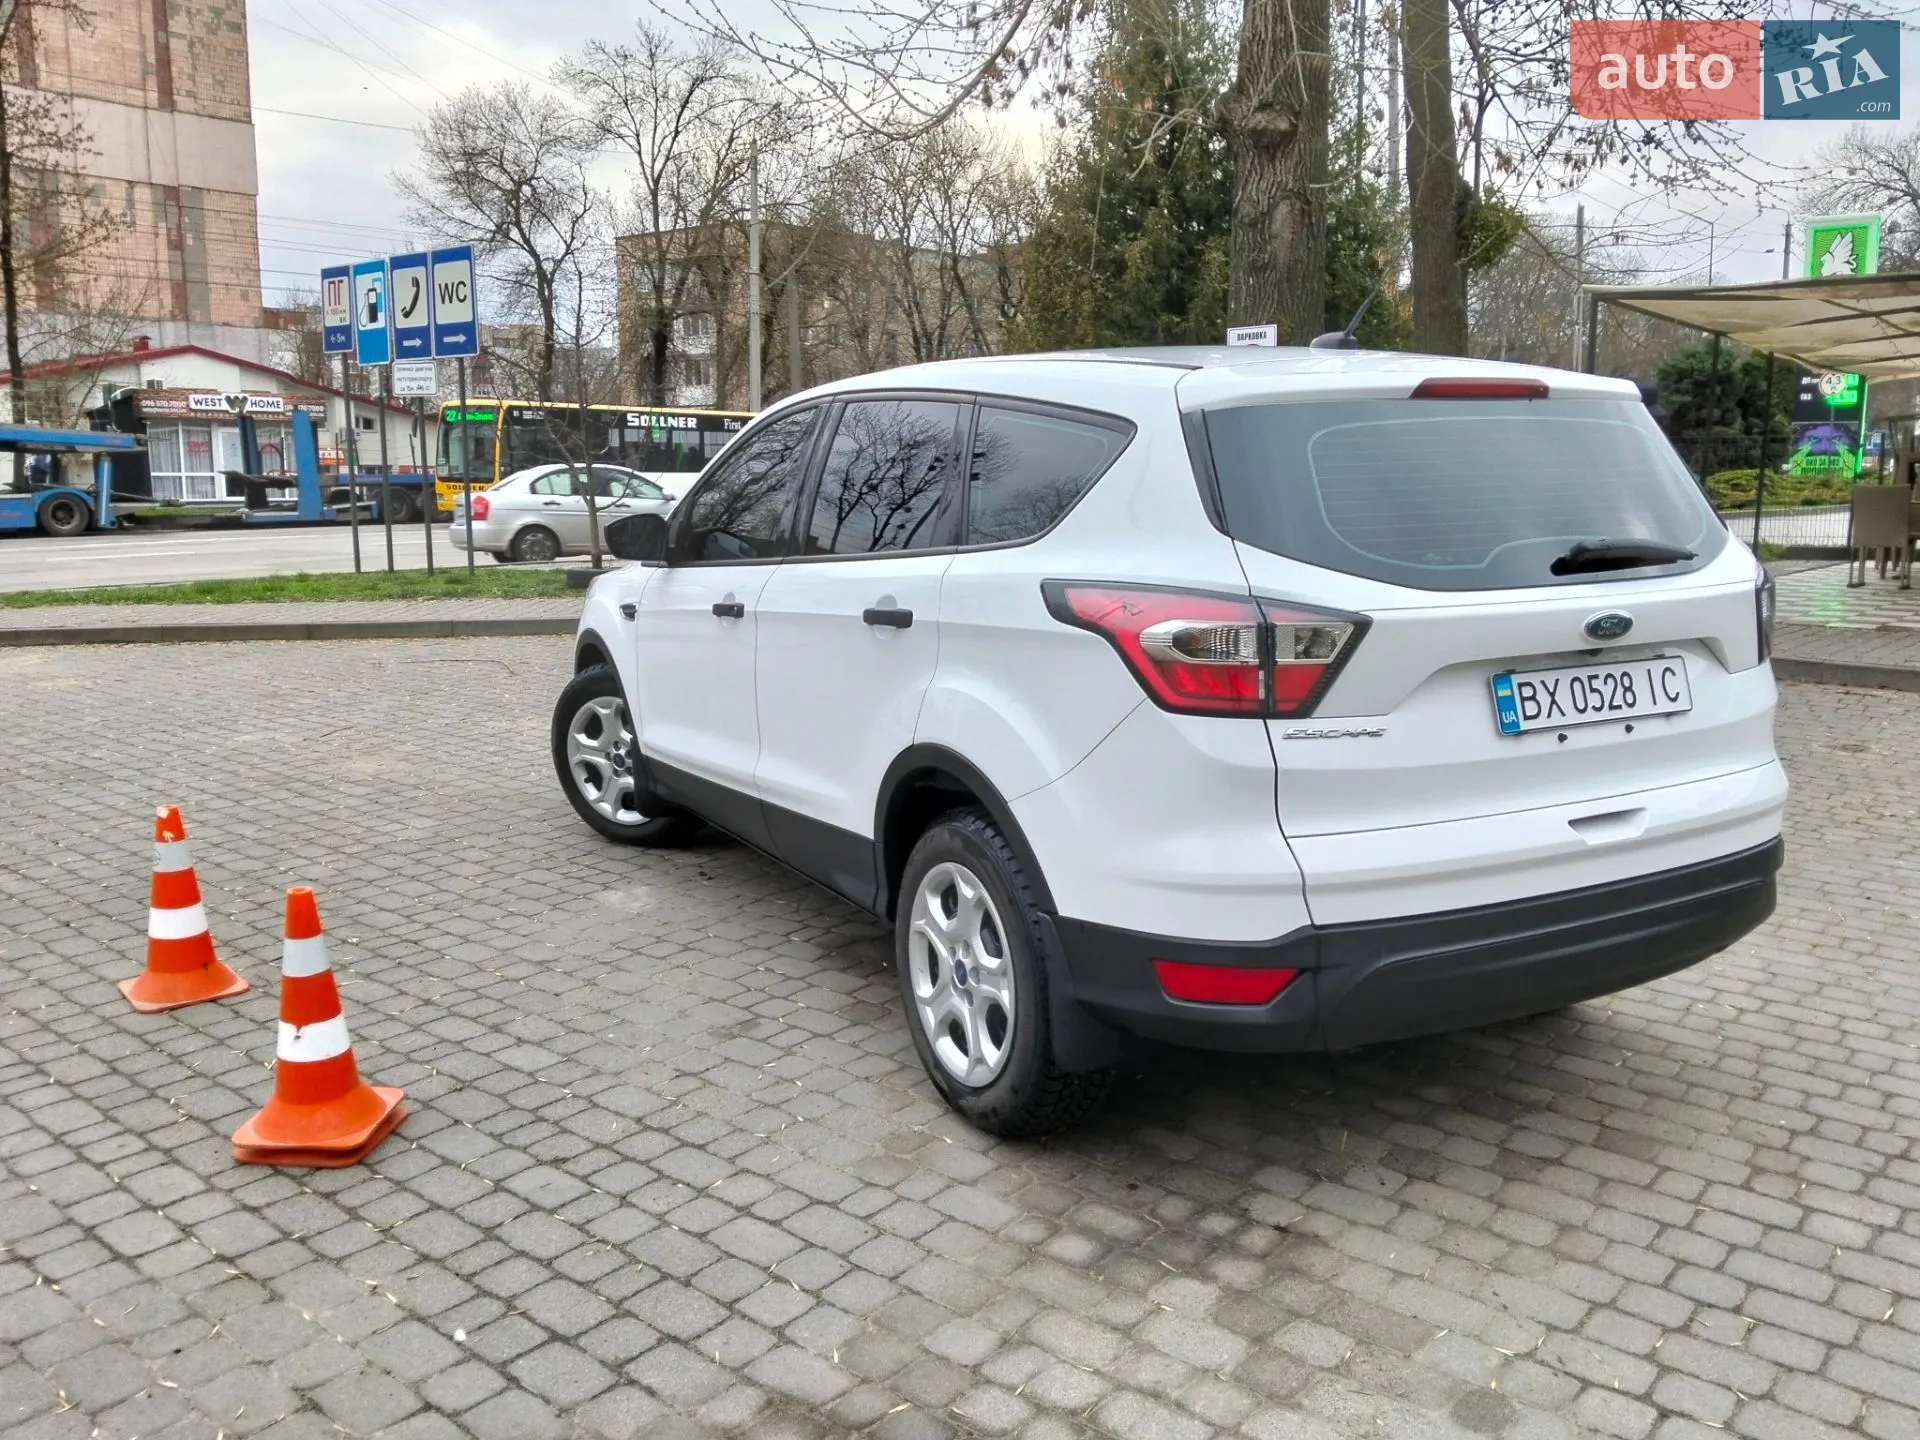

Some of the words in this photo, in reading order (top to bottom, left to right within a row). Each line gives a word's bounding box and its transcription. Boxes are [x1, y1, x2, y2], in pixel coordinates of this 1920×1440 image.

[328, 279, 344, 307] ПГ
[438, 280, 467, 305] WC
[1236, 331, 1267, 341] ПАРКОВКА
[192, 397, 223, 407] WEST
[251, 400, 282, 409] HOME
[1517, 677, 1566, 721] BX
[1569, 670, 1637, 714] 0528
[1646, 666, 1680, 706] IC
[1502, 710, 1518, 723] UA
[1282, 727, 1388, 740] ESCAPE
